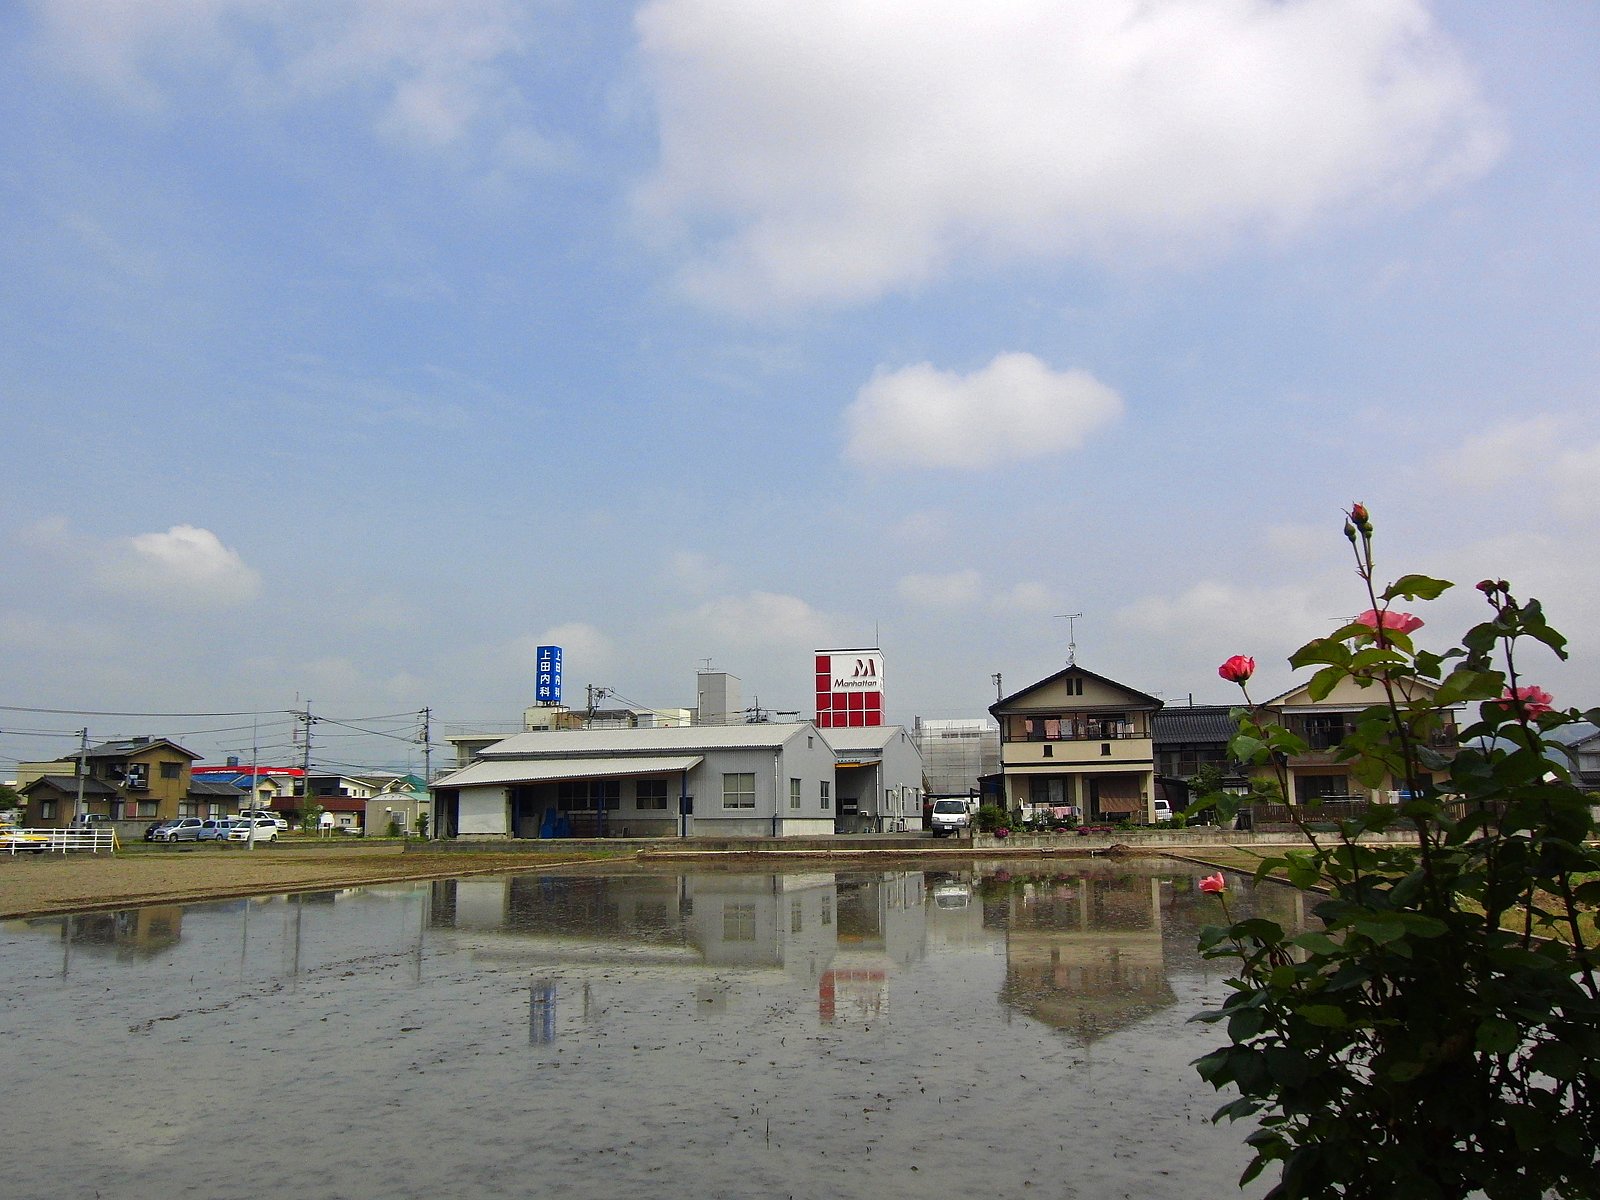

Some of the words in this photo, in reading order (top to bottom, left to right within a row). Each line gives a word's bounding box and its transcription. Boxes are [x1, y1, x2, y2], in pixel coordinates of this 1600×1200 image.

[540, 650, 550, 697] 上田内科
[834, 678, 877, 687] Manhattan
